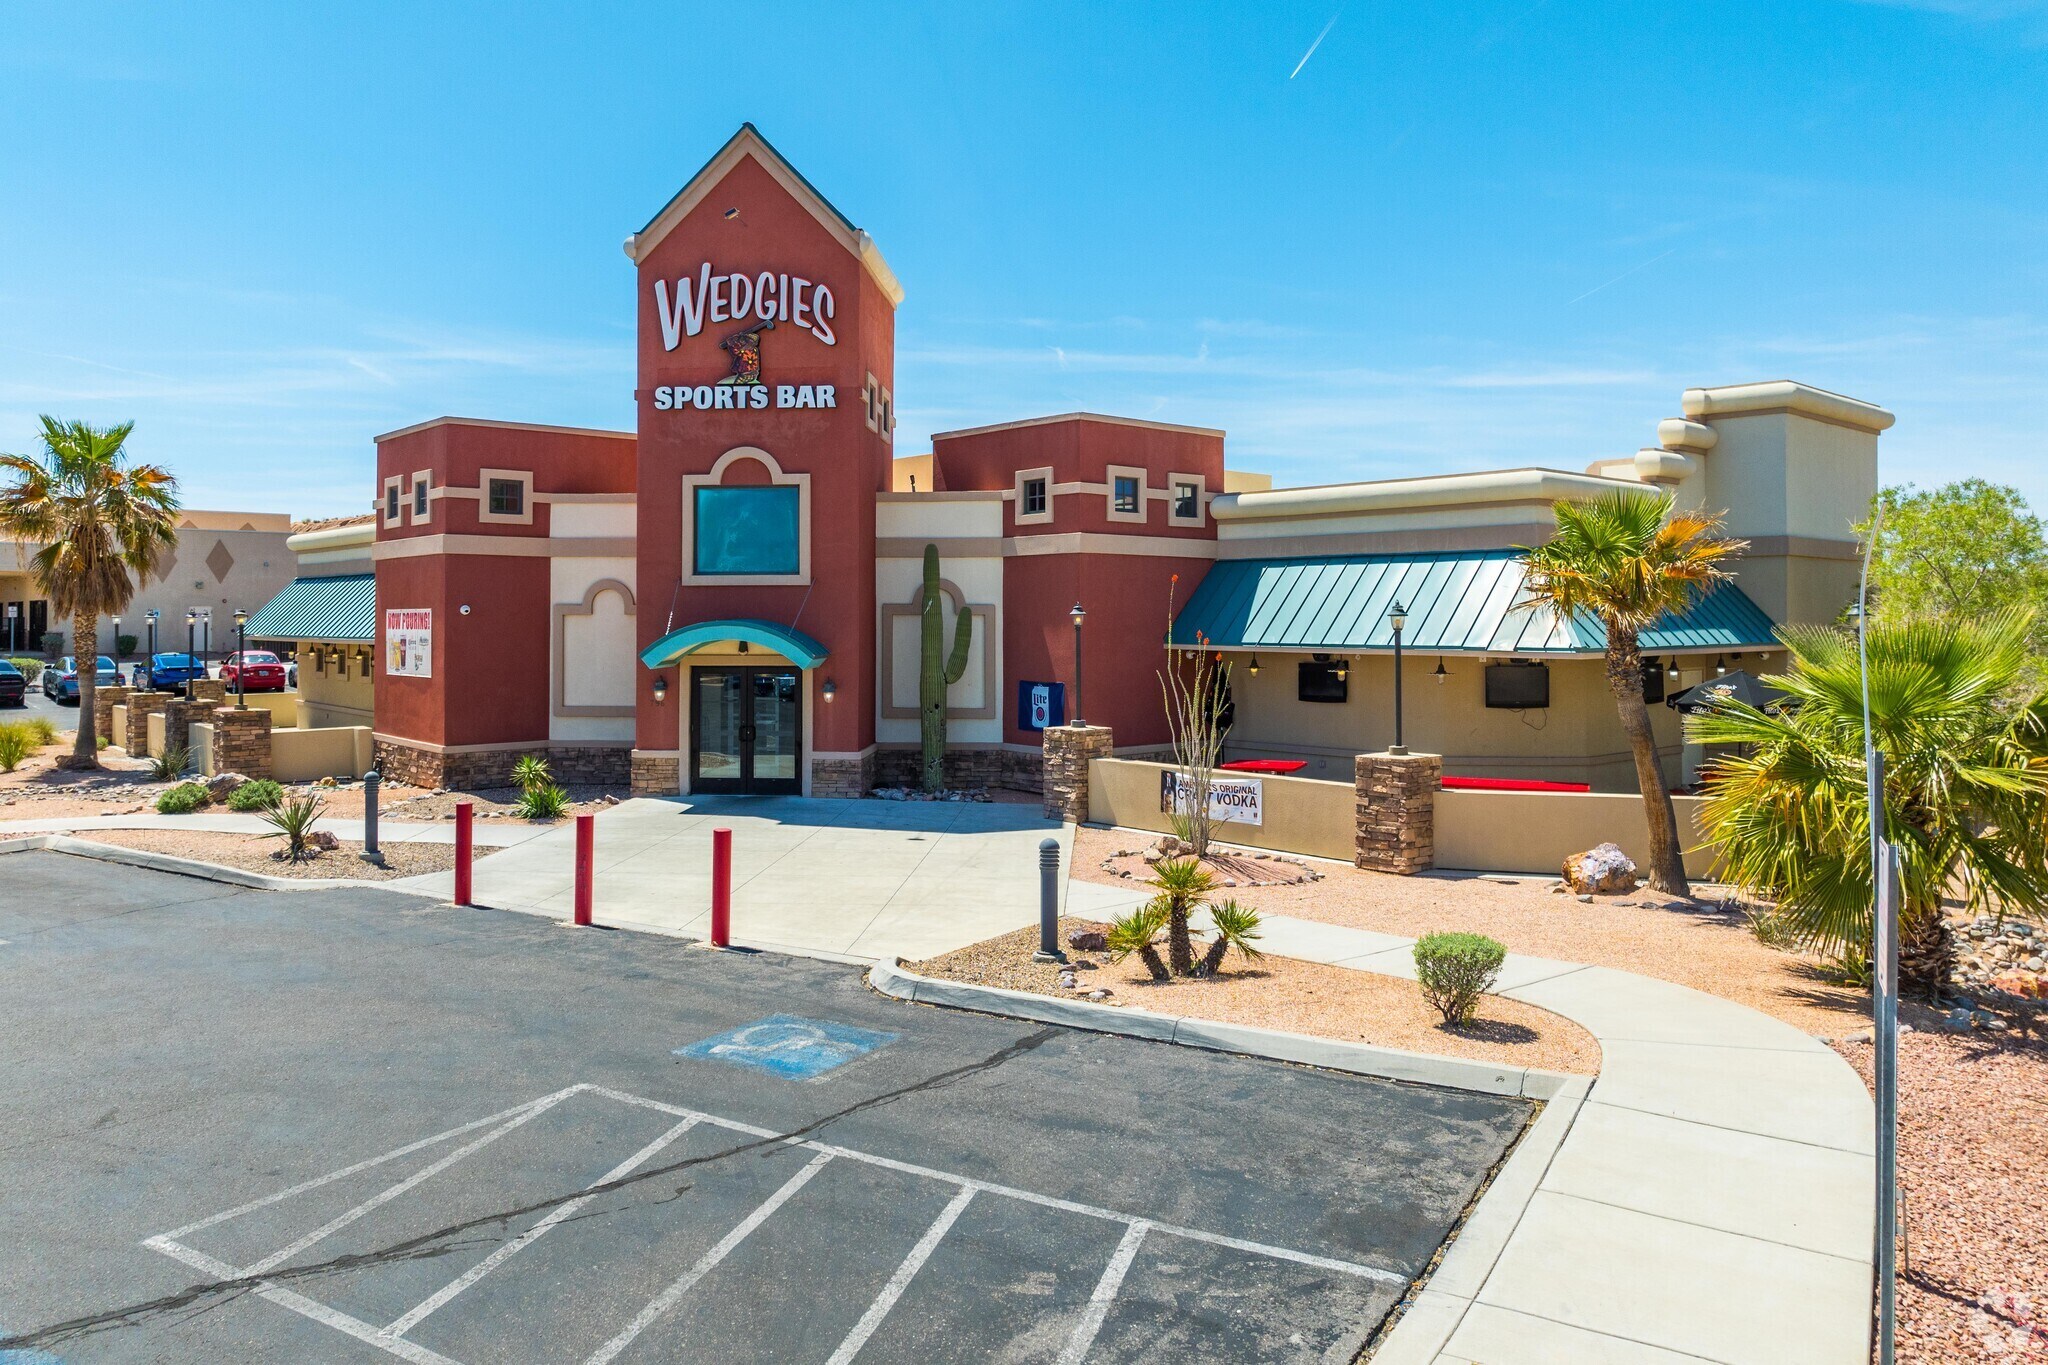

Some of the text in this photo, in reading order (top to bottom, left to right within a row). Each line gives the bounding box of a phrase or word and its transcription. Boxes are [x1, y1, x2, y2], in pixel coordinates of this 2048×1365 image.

[654, 262, 837, 352] WEDGIES
[654, 385, 837, 410] SPORTS BAR
[388, 612, 430, 630] NOW POURING!
[1034, 694, 1047, 706] Lite
[1219, 784, 1258, 796] ORIGINAL
[1216, 792, 1258, 809] VODKA
